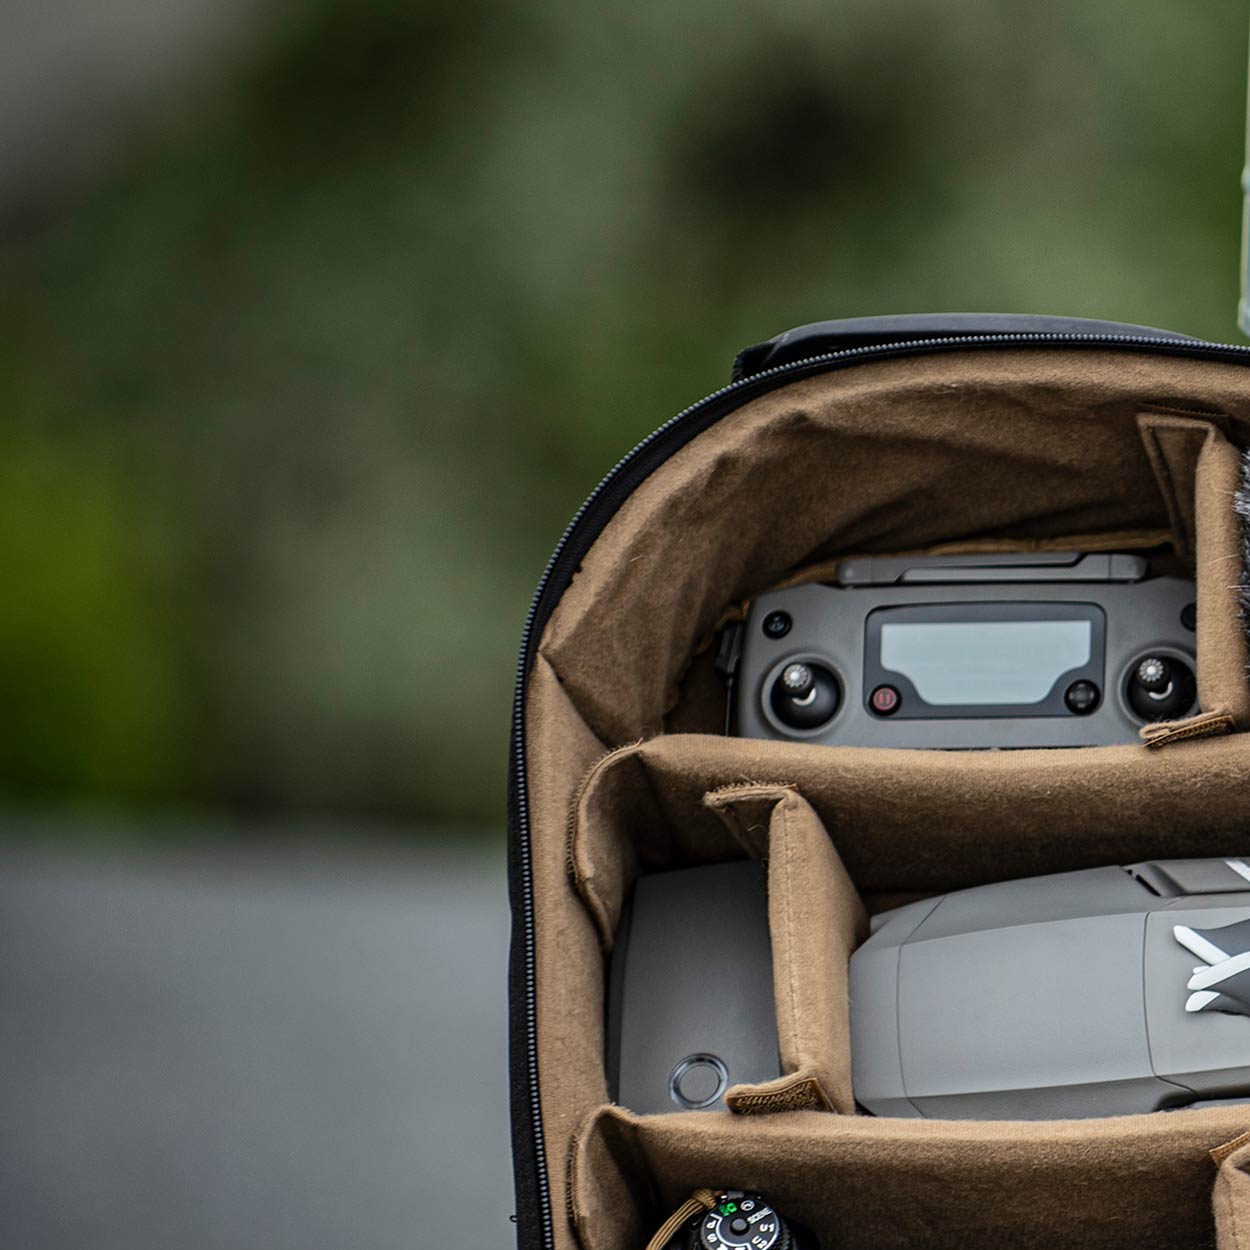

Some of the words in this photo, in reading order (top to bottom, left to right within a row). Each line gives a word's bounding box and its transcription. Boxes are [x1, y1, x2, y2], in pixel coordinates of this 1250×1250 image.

[760, 1224, 775, 1232] U1
[707, 1234, 717, 1243] S
[752, 1236, 767, 1249] U2
